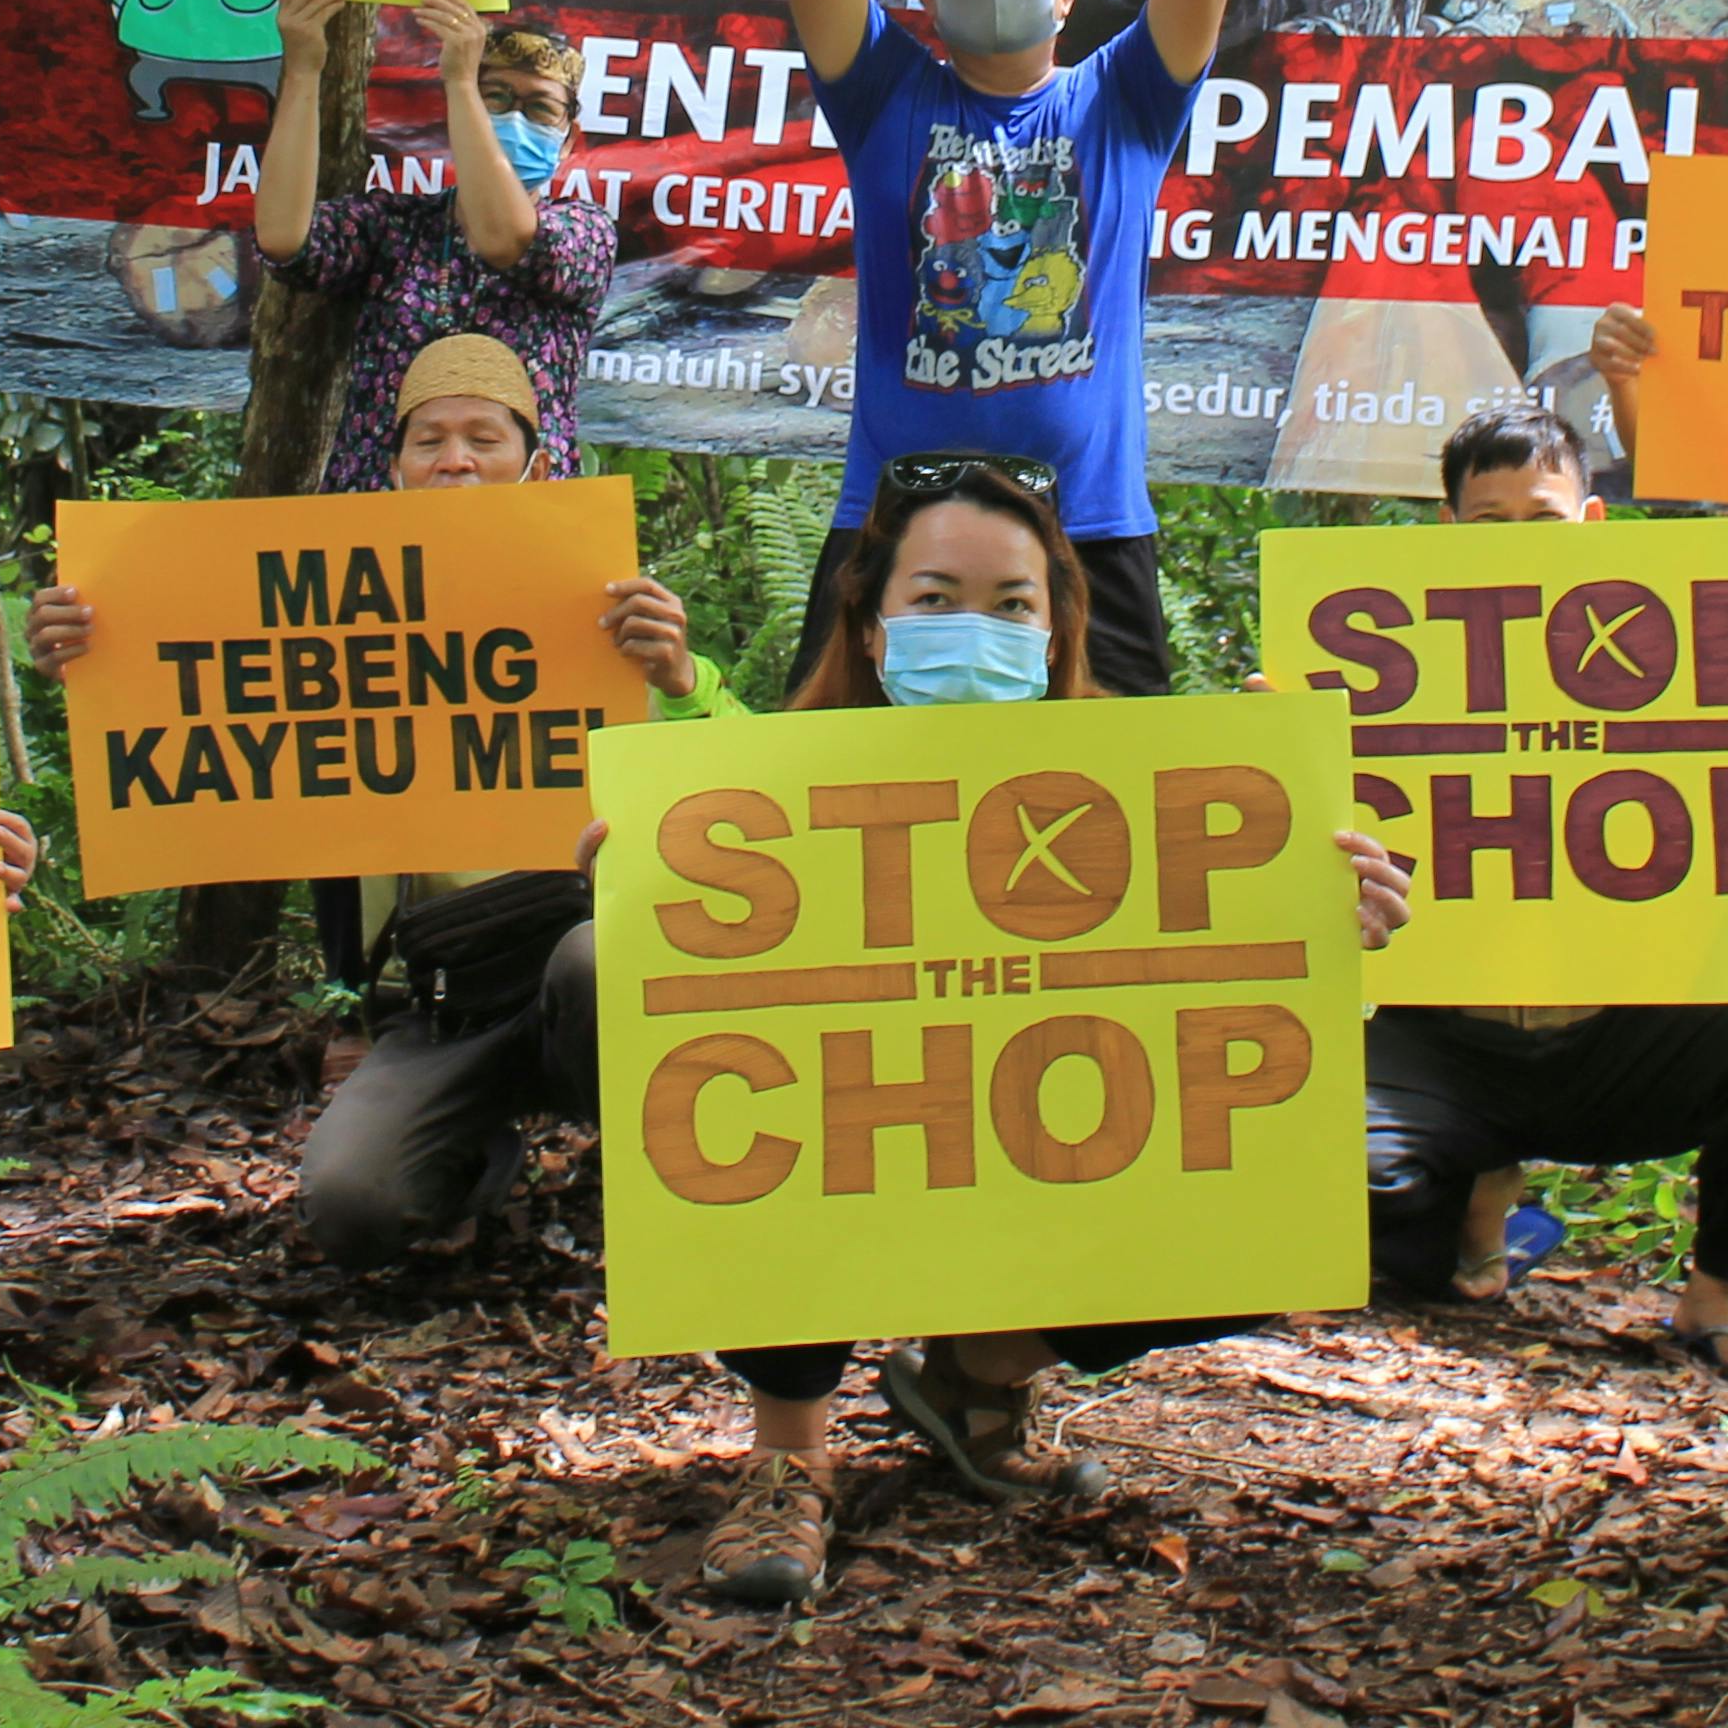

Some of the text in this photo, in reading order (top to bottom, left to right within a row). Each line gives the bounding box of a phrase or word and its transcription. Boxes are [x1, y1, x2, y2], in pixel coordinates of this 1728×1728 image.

[652, 174, 855, 238] CERITA
[1233, 210, 1589, 270] MENGENAI
[905, 335, 1096, 390] the Street
[1314, 381, 1446, 427] tiada
[257, 545, 426, 627] MAI
[157, 626, 538, 716] TEBENG
[106, 715, 416, 809] KAYEU
[1511, 721, 1598, 751] THE
[654, 765, 1292, 959] STOP
[923, 955, 1031, 998] THE
[642, 1005, 1312, 1205] CHOP
